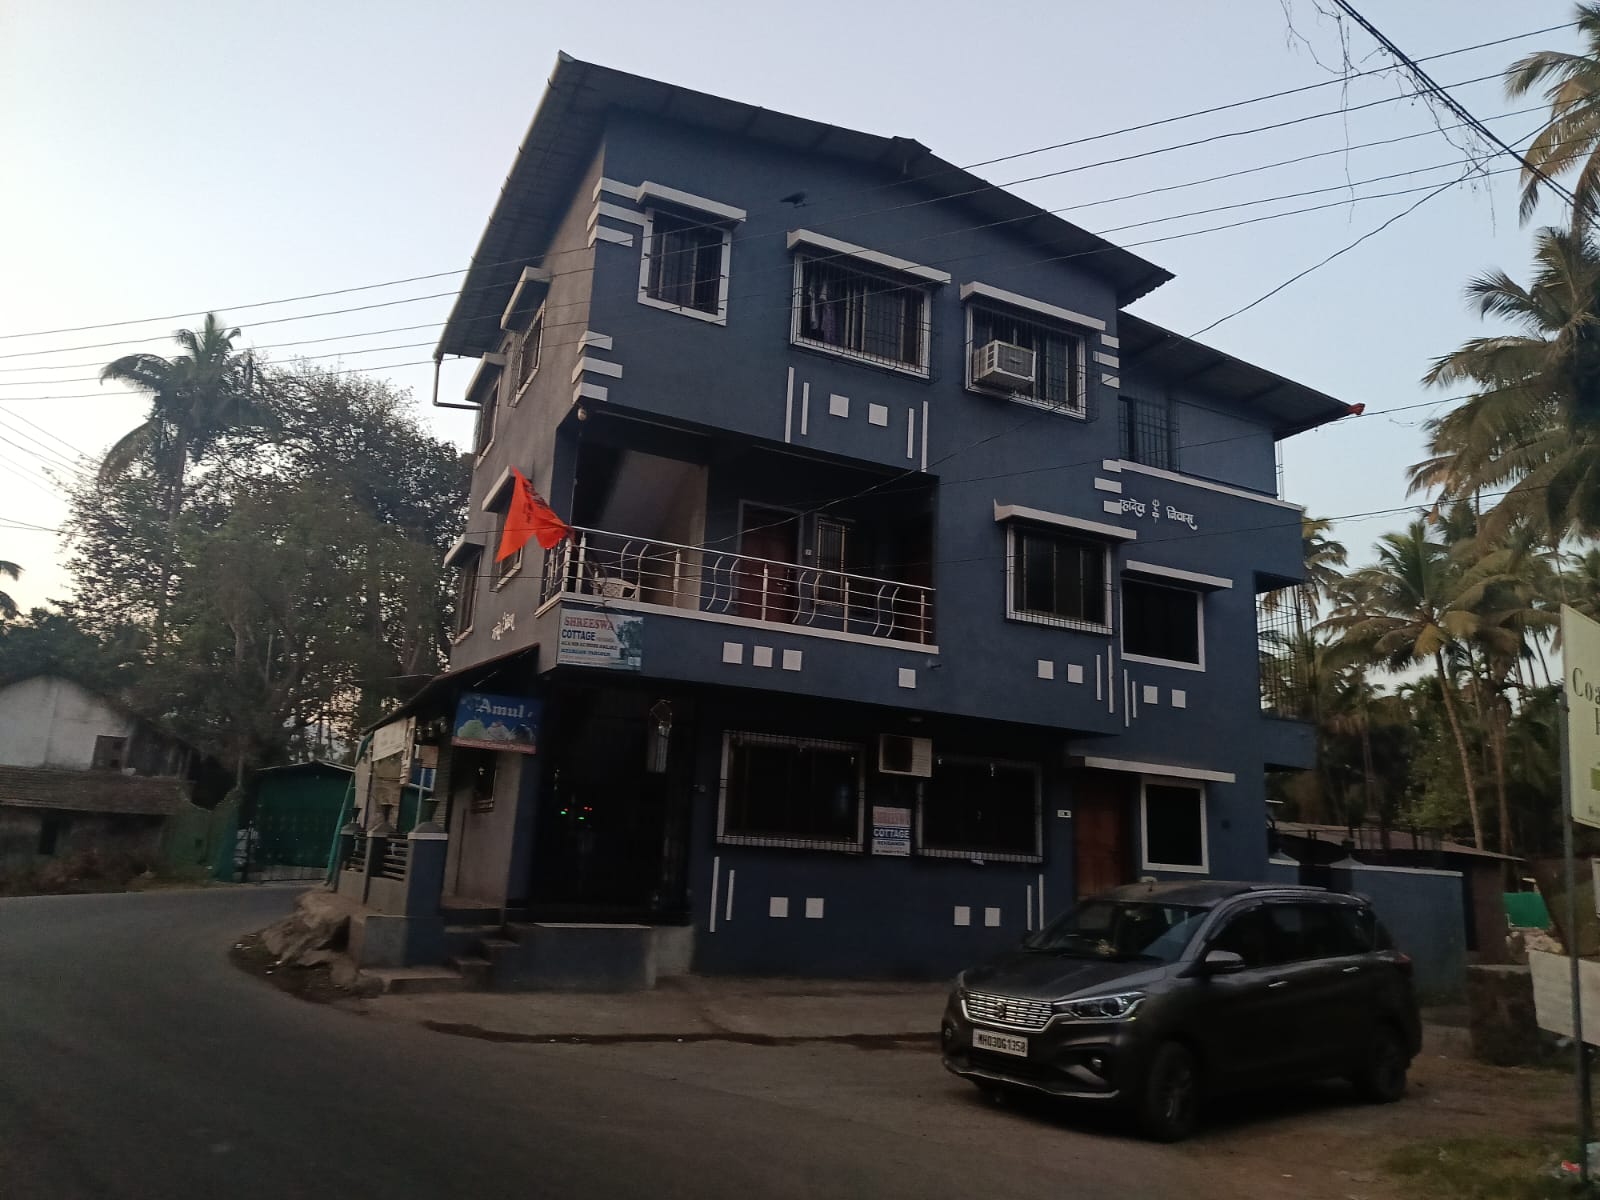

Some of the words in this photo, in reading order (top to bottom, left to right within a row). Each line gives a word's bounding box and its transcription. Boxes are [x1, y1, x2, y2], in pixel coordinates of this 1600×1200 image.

[561, 629, 596, 641] COTTAGE
[476, 698, 525, 718] Amul
[873, 828, 910, 839] COTTAGE
